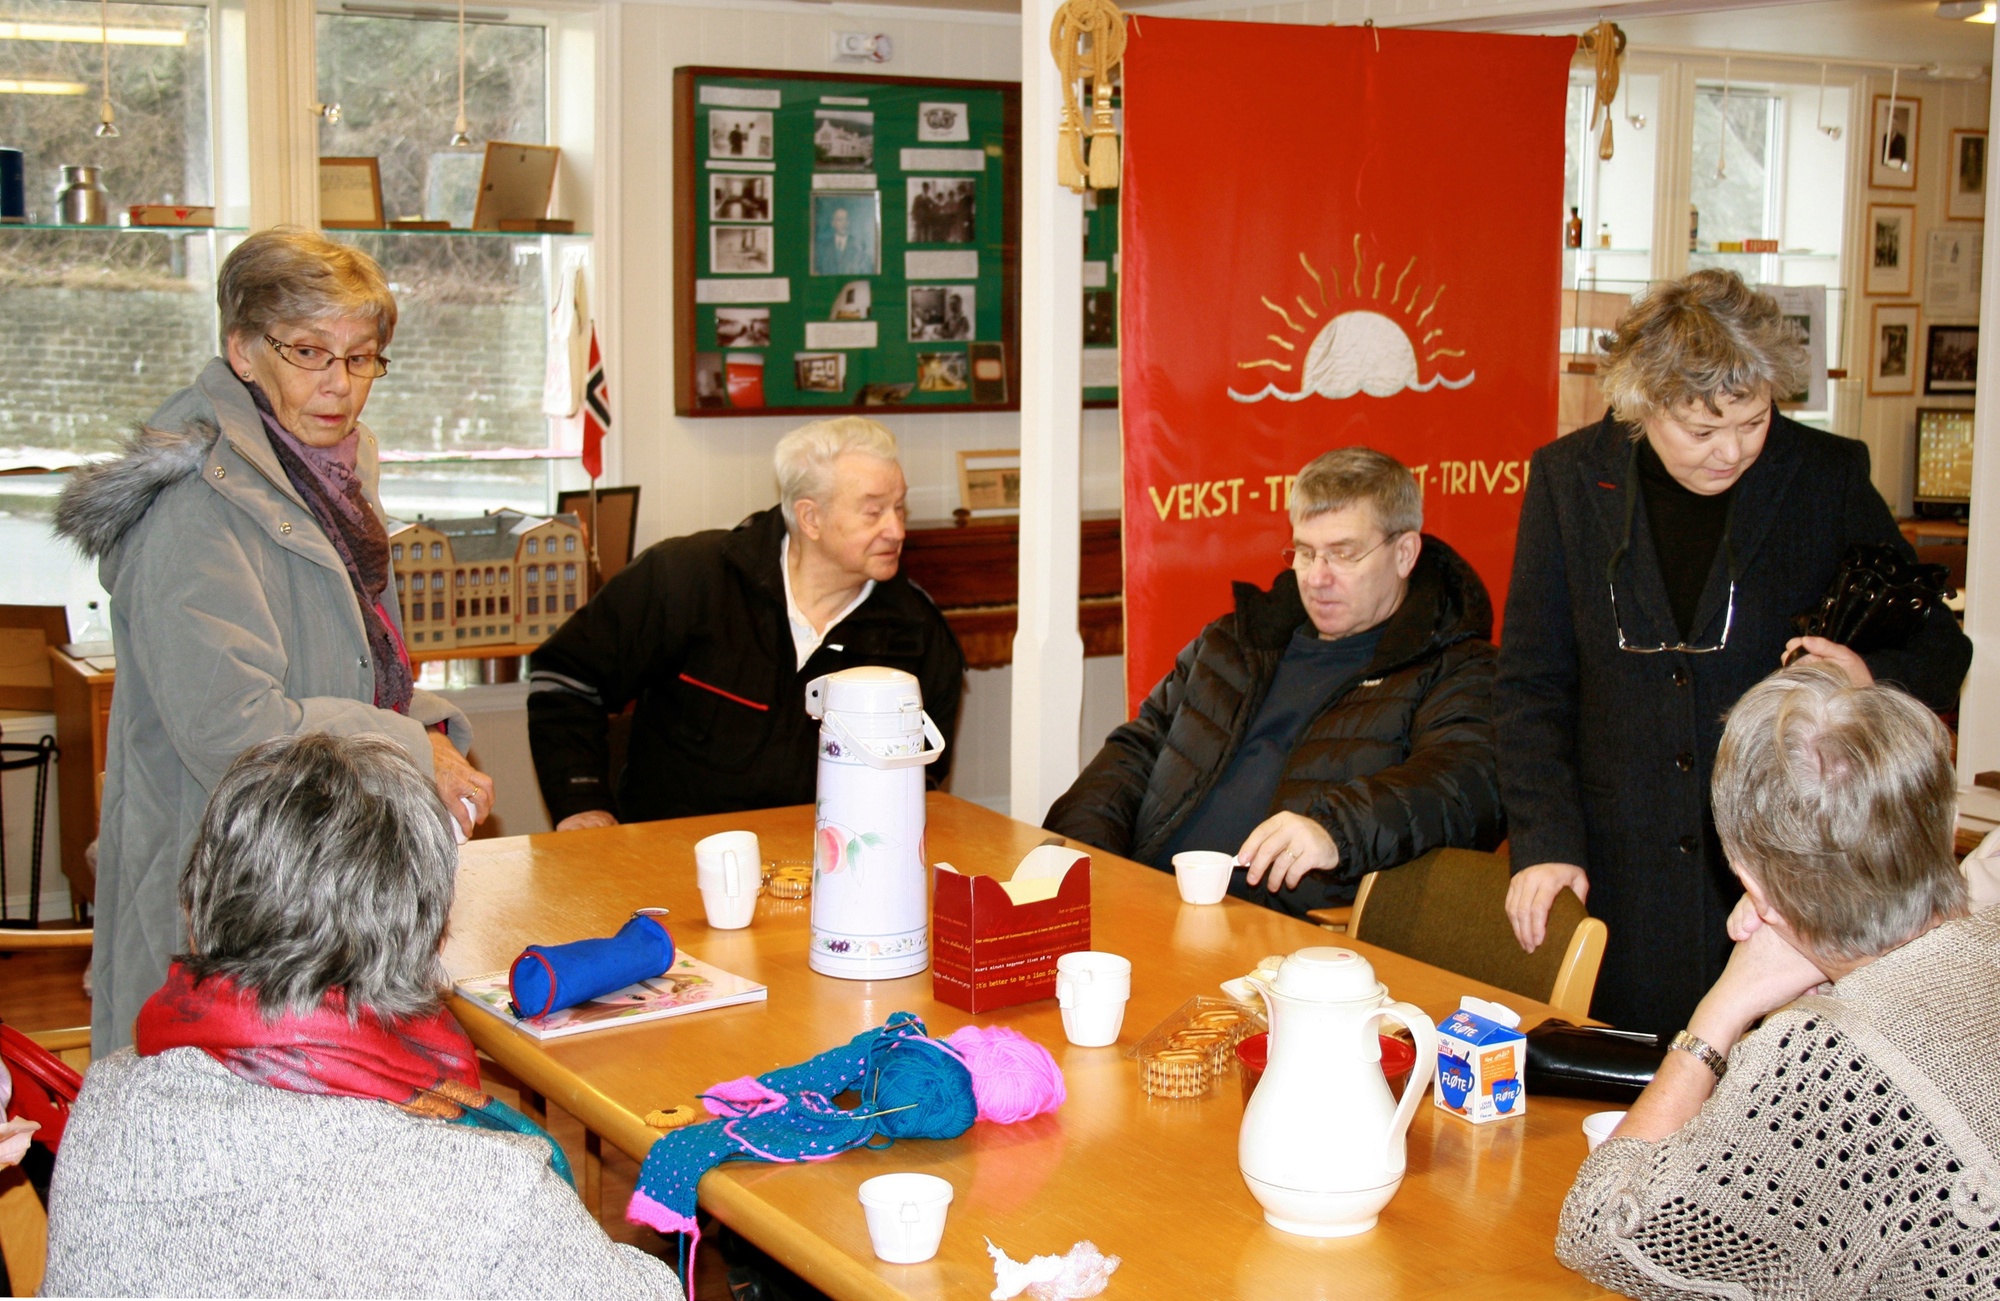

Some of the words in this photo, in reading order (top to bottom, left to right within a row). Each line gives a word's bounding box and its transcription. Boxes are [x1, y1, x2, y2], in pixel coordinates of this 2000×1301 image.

[1148, 478, 1245, 521] VEKST
[989, 978, 1009, 987] better
[1033, 971, 1046, 979] lion
[1449, 1022, 1478, 1037] FLØTE
[1441, 1071, 1467, 1092] FLØTE
[1495, 1090, 1515, 1102] FLØTE
